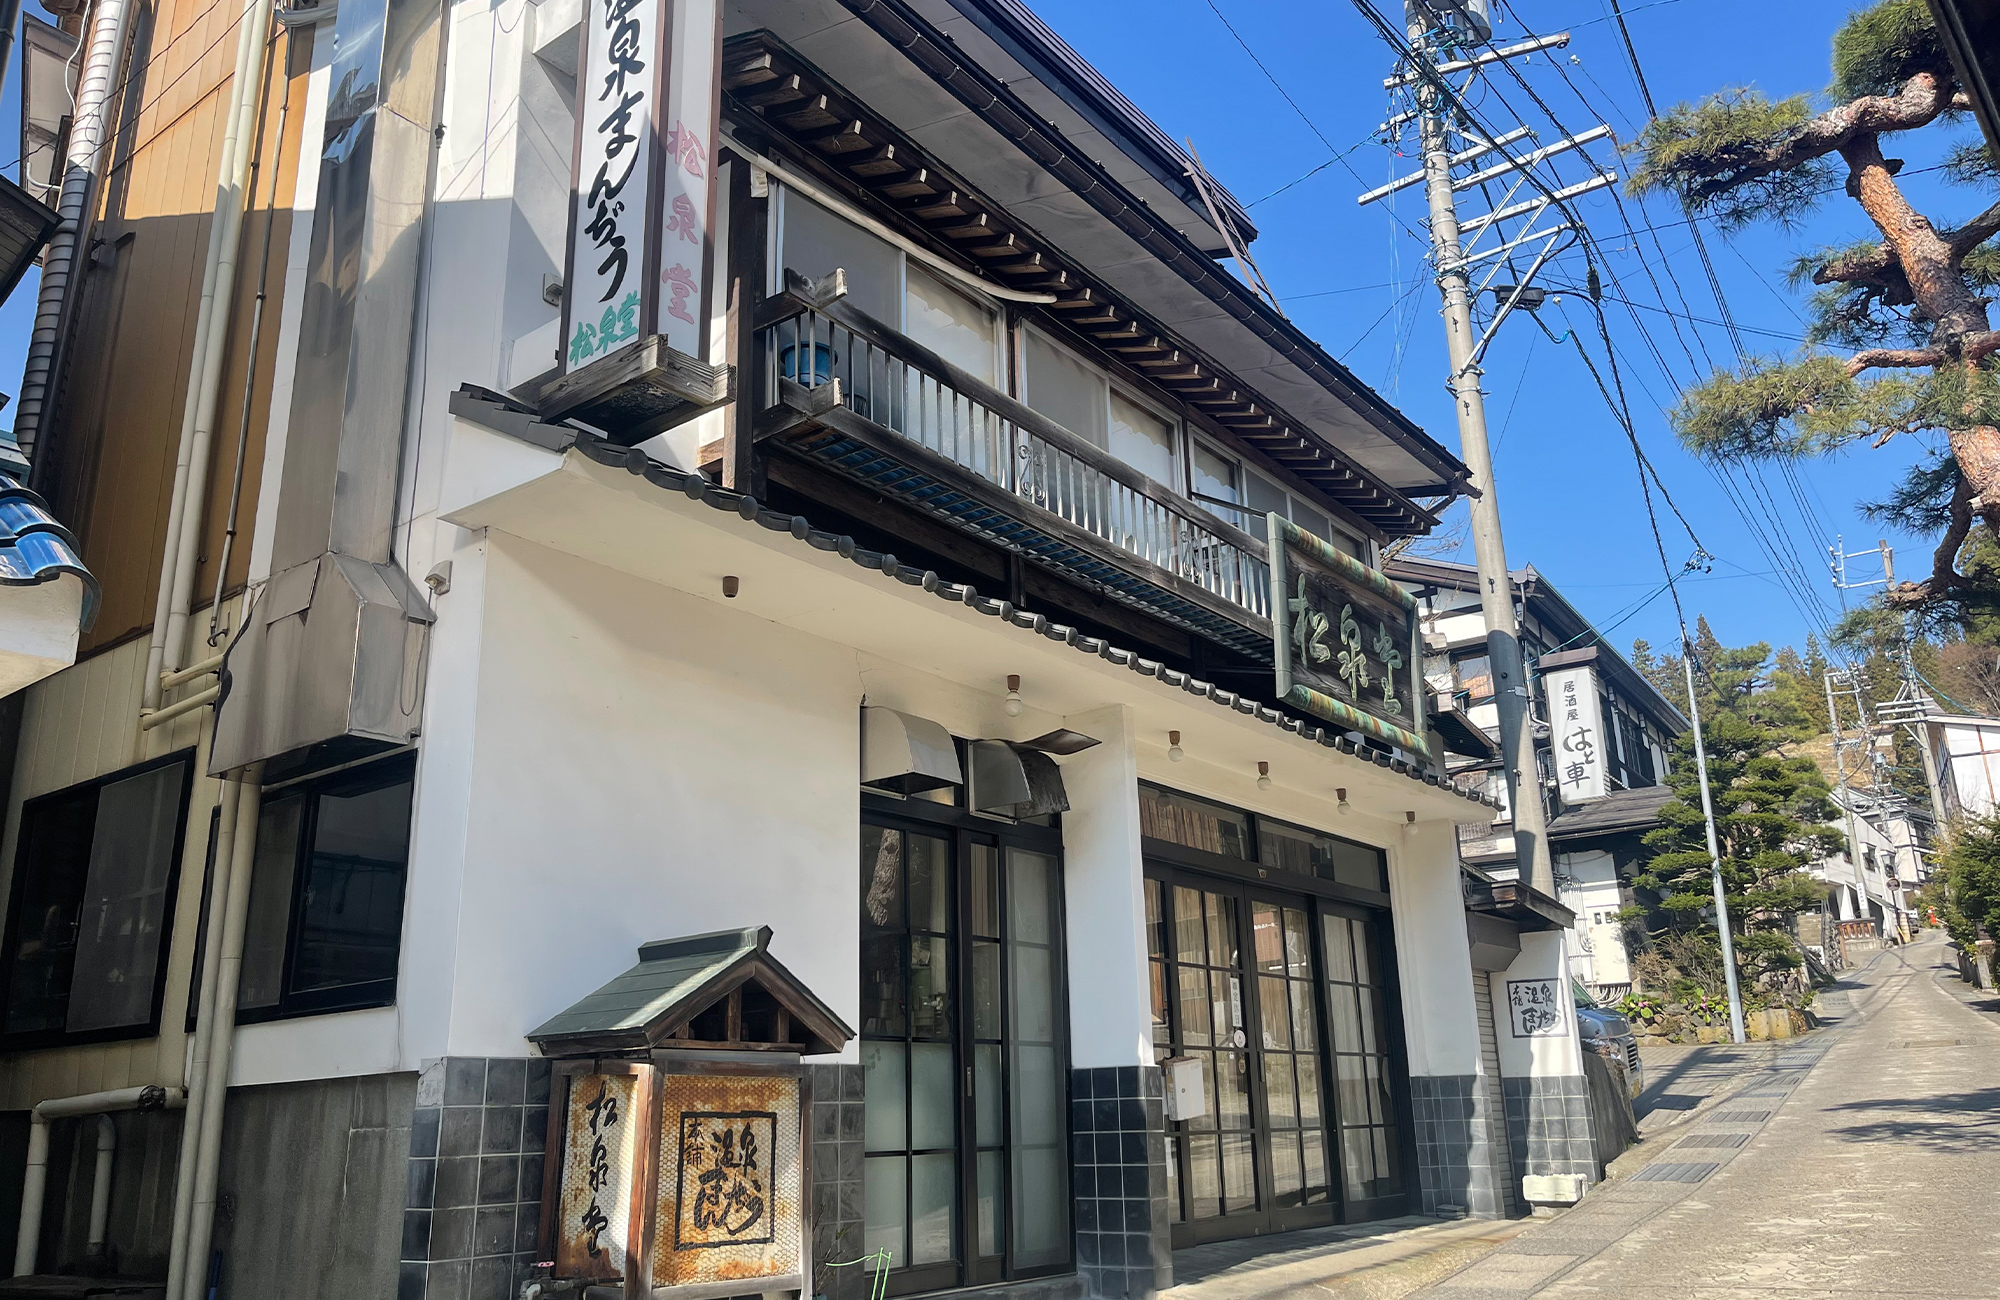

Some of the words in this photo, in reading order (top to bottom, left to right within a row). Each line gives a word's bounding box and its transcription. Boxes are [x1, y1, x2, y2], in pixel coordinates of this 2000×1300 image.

[662, 120, 706, 325] 松泉堂
[569, 290, 641, 366] 松泉堂
[1563, 681, 1579, 722] 居酒屋
[1561, 726, 1595, 790] はと車
[710, 1122, 758, 1178] 温泉
